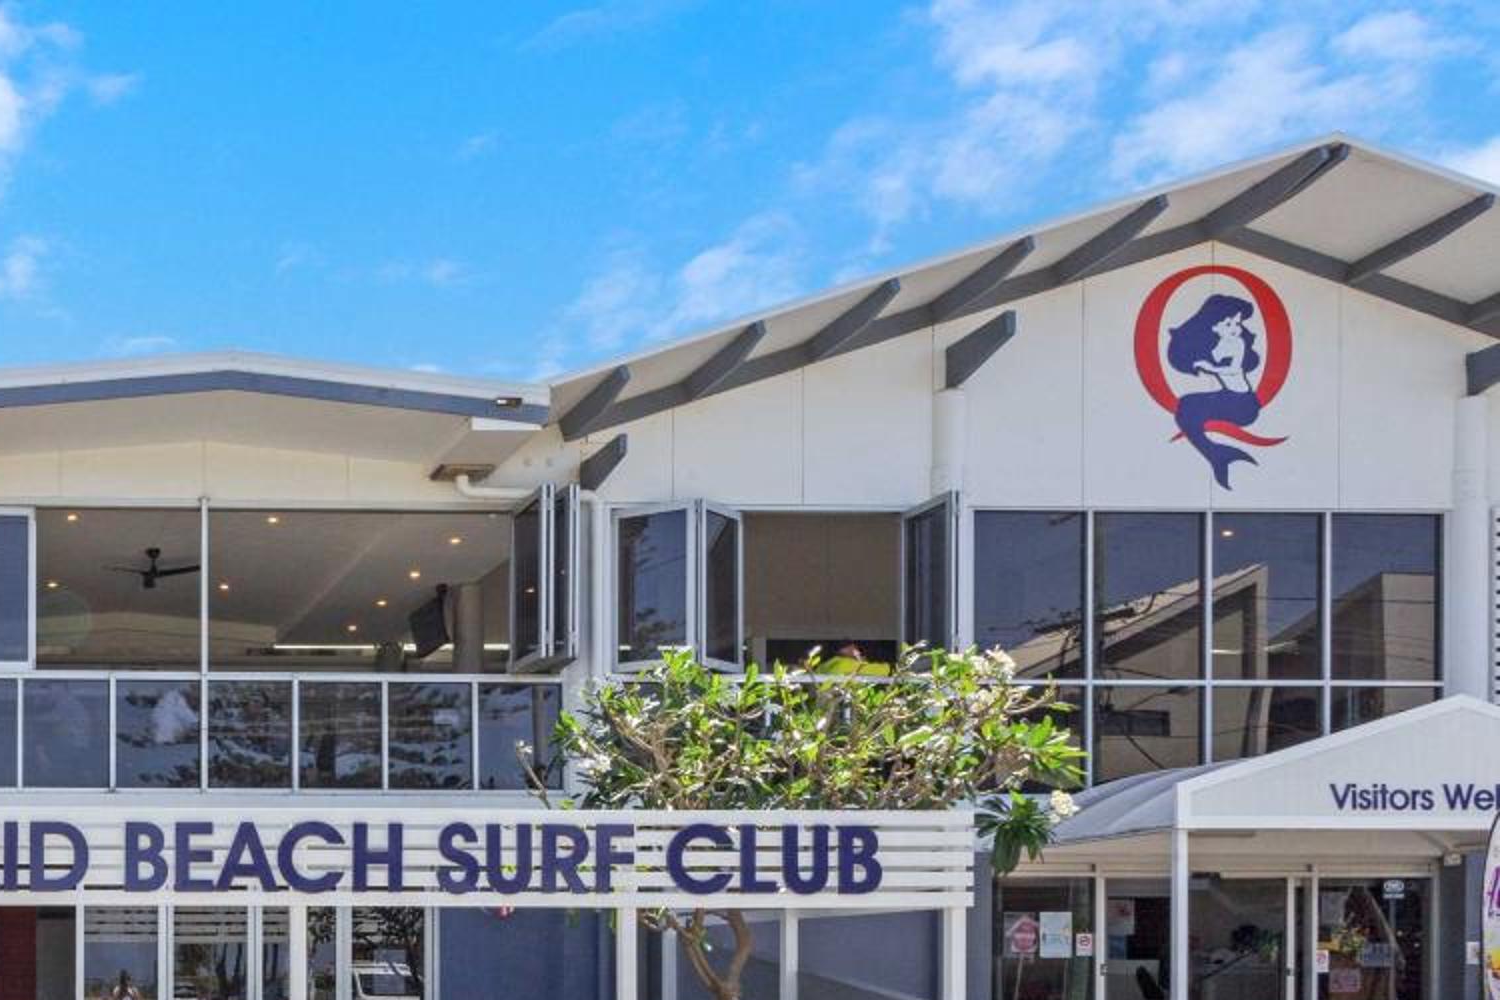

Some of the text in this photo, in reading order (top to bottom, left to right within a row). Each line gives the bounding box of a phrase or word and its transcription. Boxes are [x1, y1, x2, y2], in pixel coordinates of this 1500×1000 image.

[1329, 783, 1435, 811] Visitors
[124, 821, 402, 893] BEACH
[437, 822, 635, 894] SURF
[666, 823, 883, 895] CLUB
